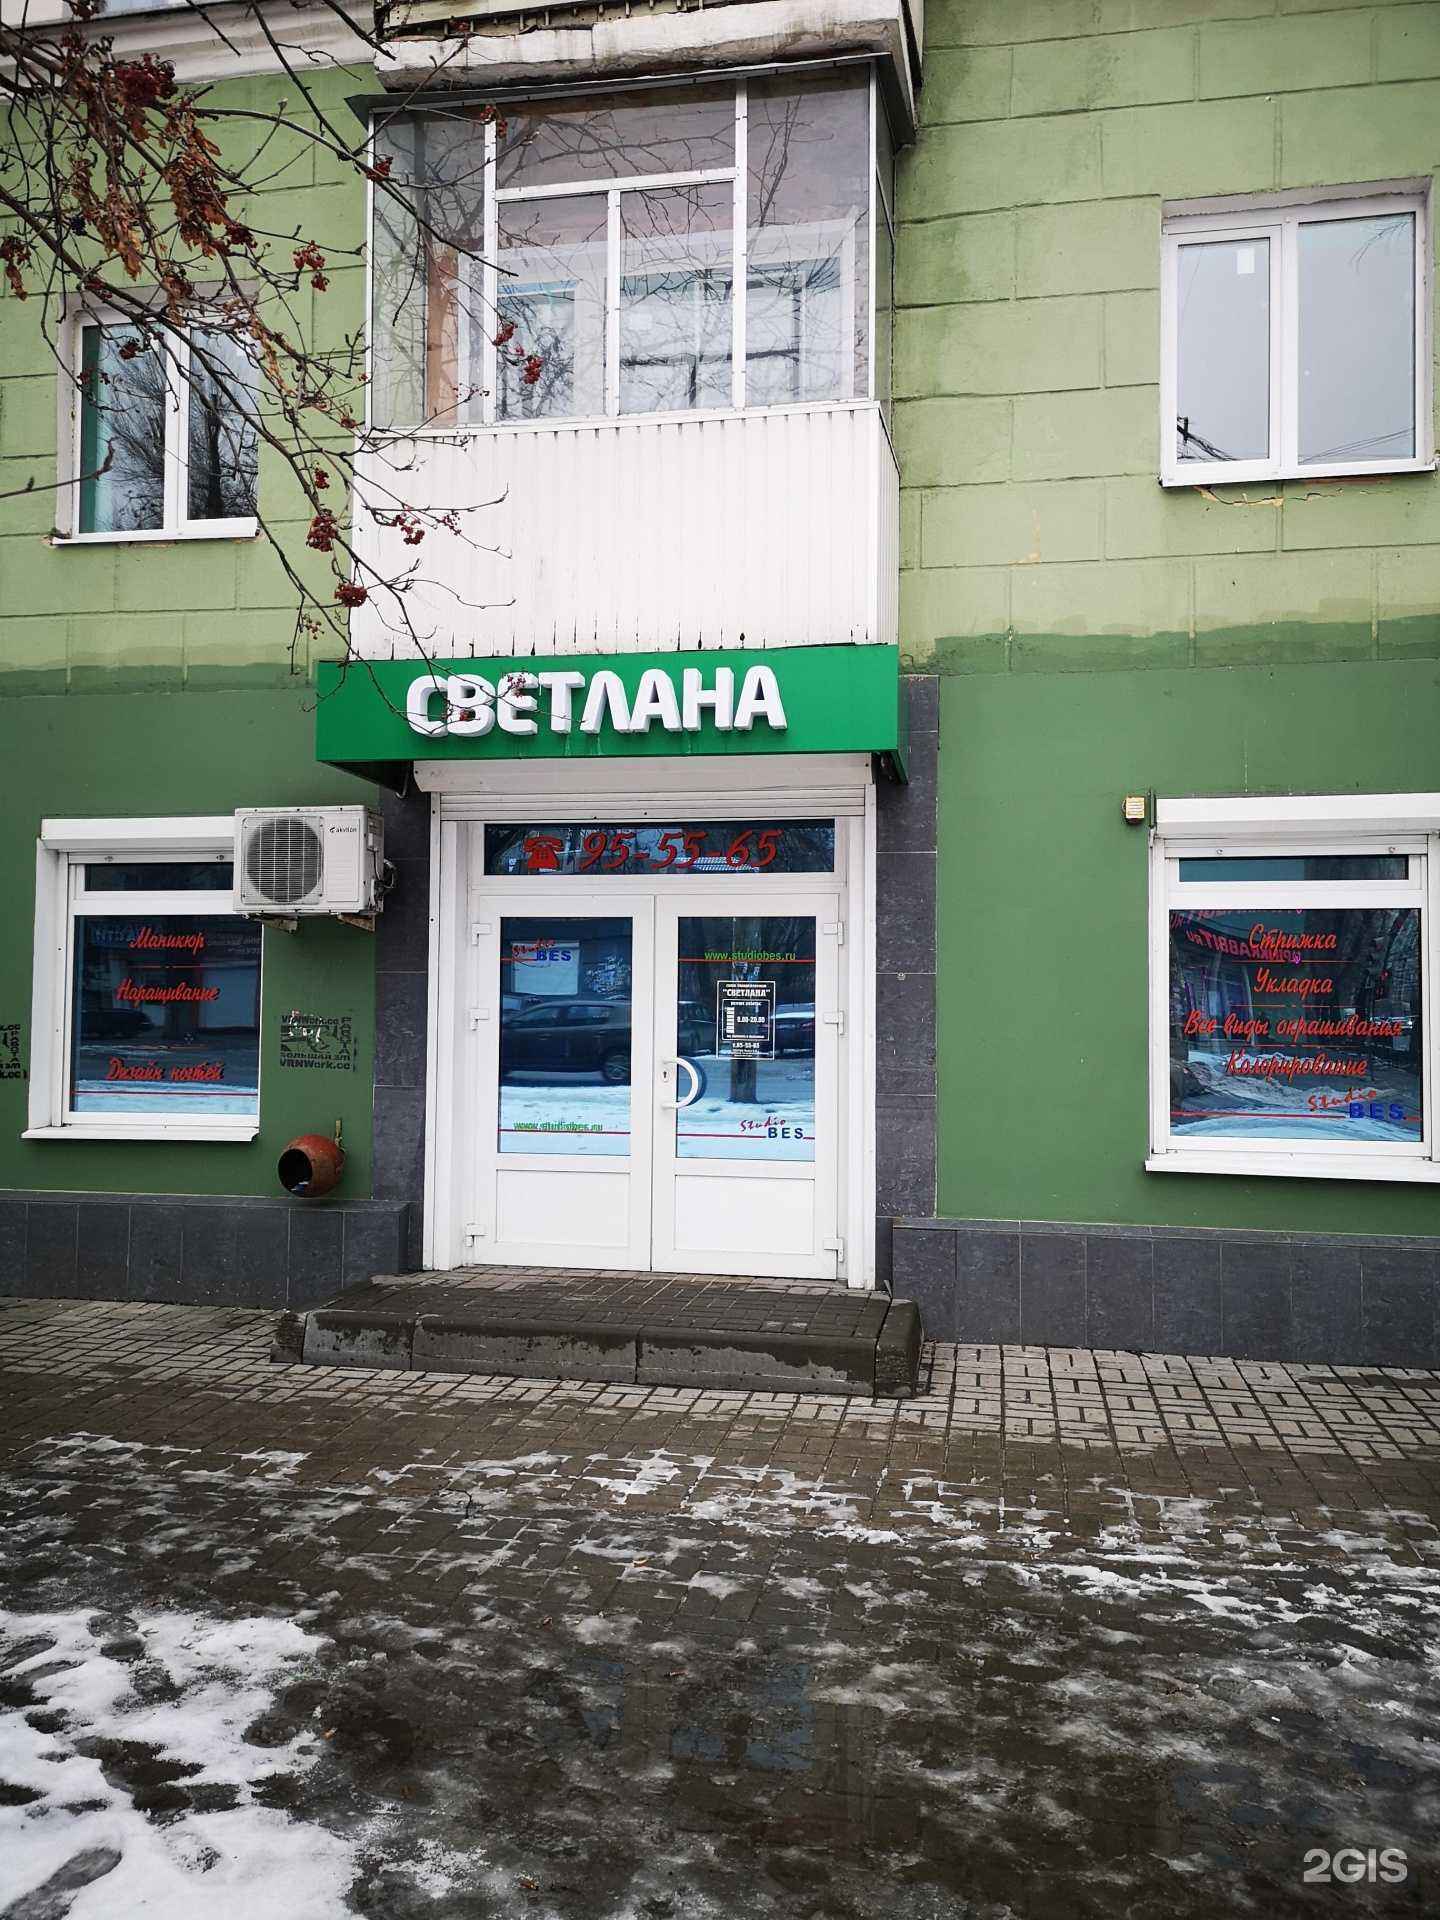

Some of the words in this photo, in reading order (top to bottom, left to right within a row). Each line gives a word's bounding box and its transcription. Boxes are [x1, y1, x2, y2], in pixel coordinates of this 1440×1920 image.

[406, 665, 787, 737] СВЕТЛАНА
[579, 829, 783, 870] 95-55-65
[128, 926, 206, 955] Маникюр
[1248, 923, 1337, 955] Стрижка
[535, 949, 572, 962] BES
[704, 950, 796, 961] www.studiobes.ru
[115, 977, 221, 1007] Наращивание
[1253, 968, 1334, 1000] Укладка
[1184, 1009, 1215, 1035] Все
[1224, 1012, 1269, 1039] виды
[1276, 1014, 1403, 1041] окрашивания
[106, 1056, 163, 1081] Дизайн
[170, 1059, 225, 1081] ногтей
[1226, 1047, 1369, 1084] Колорирование
[1307, 1087, 1377, 1111] Studio
[1350, 1103, 1405, 1120] BES
[740, 1115, 786, 1132] Studio
[768, 1127, 804, 1139] BES
